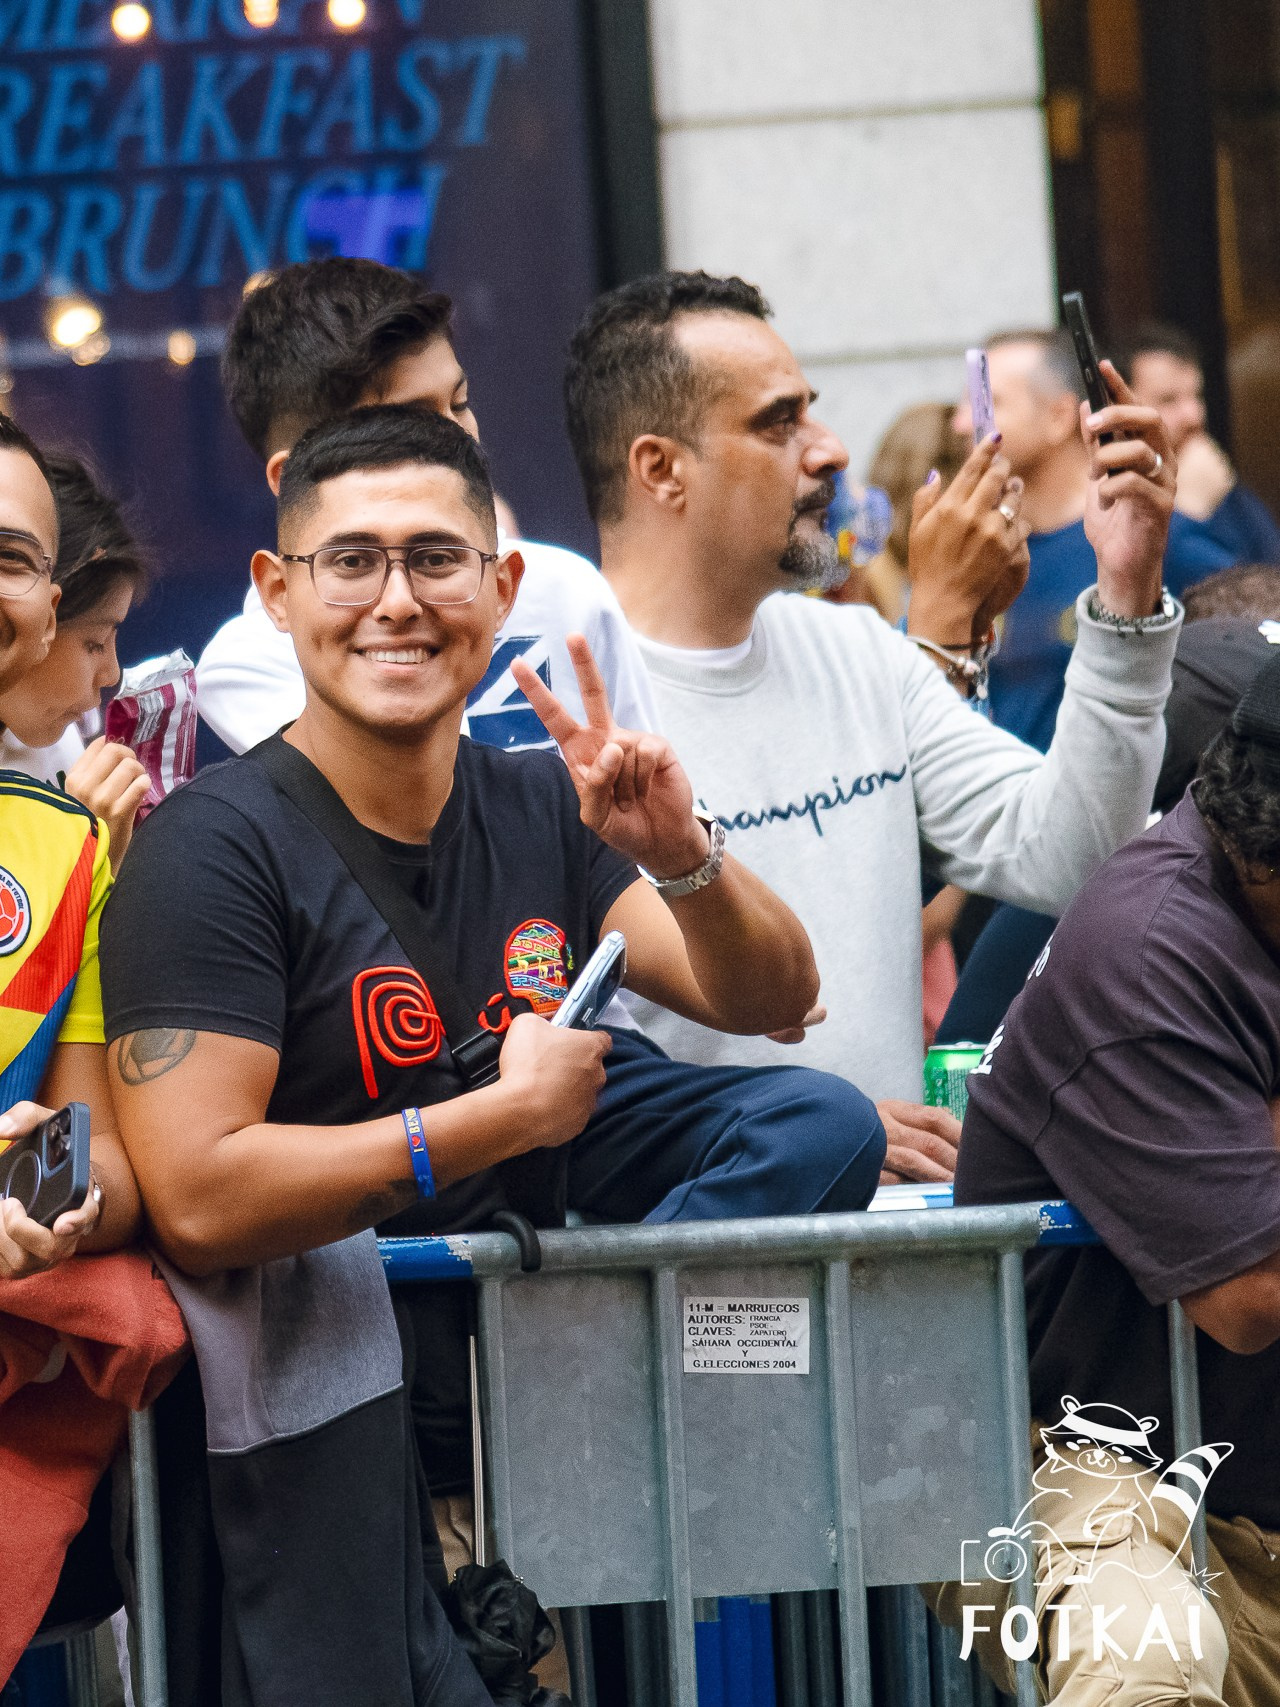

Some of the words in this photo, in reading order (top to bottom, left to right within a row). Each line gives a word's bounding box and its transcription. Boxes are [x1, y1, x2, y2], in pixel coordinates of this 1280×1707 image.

[697, 763, 907, 836] hampion
[687, 1303, 714, 1313] 11-M
[727, 1303, 800, 1313] MARRUECOS
[687, 1314, 746, 1325] AUTORES:
[687, 1326, 736, 1336] CLAVES:
[691, 1337, 732, 1347] SÁHARA
[736, 1339, 799, 1348] OCCIDENTAL
[741, 1349, 749, 1358] Y
[772, 1360, 797, 1369] 2004
